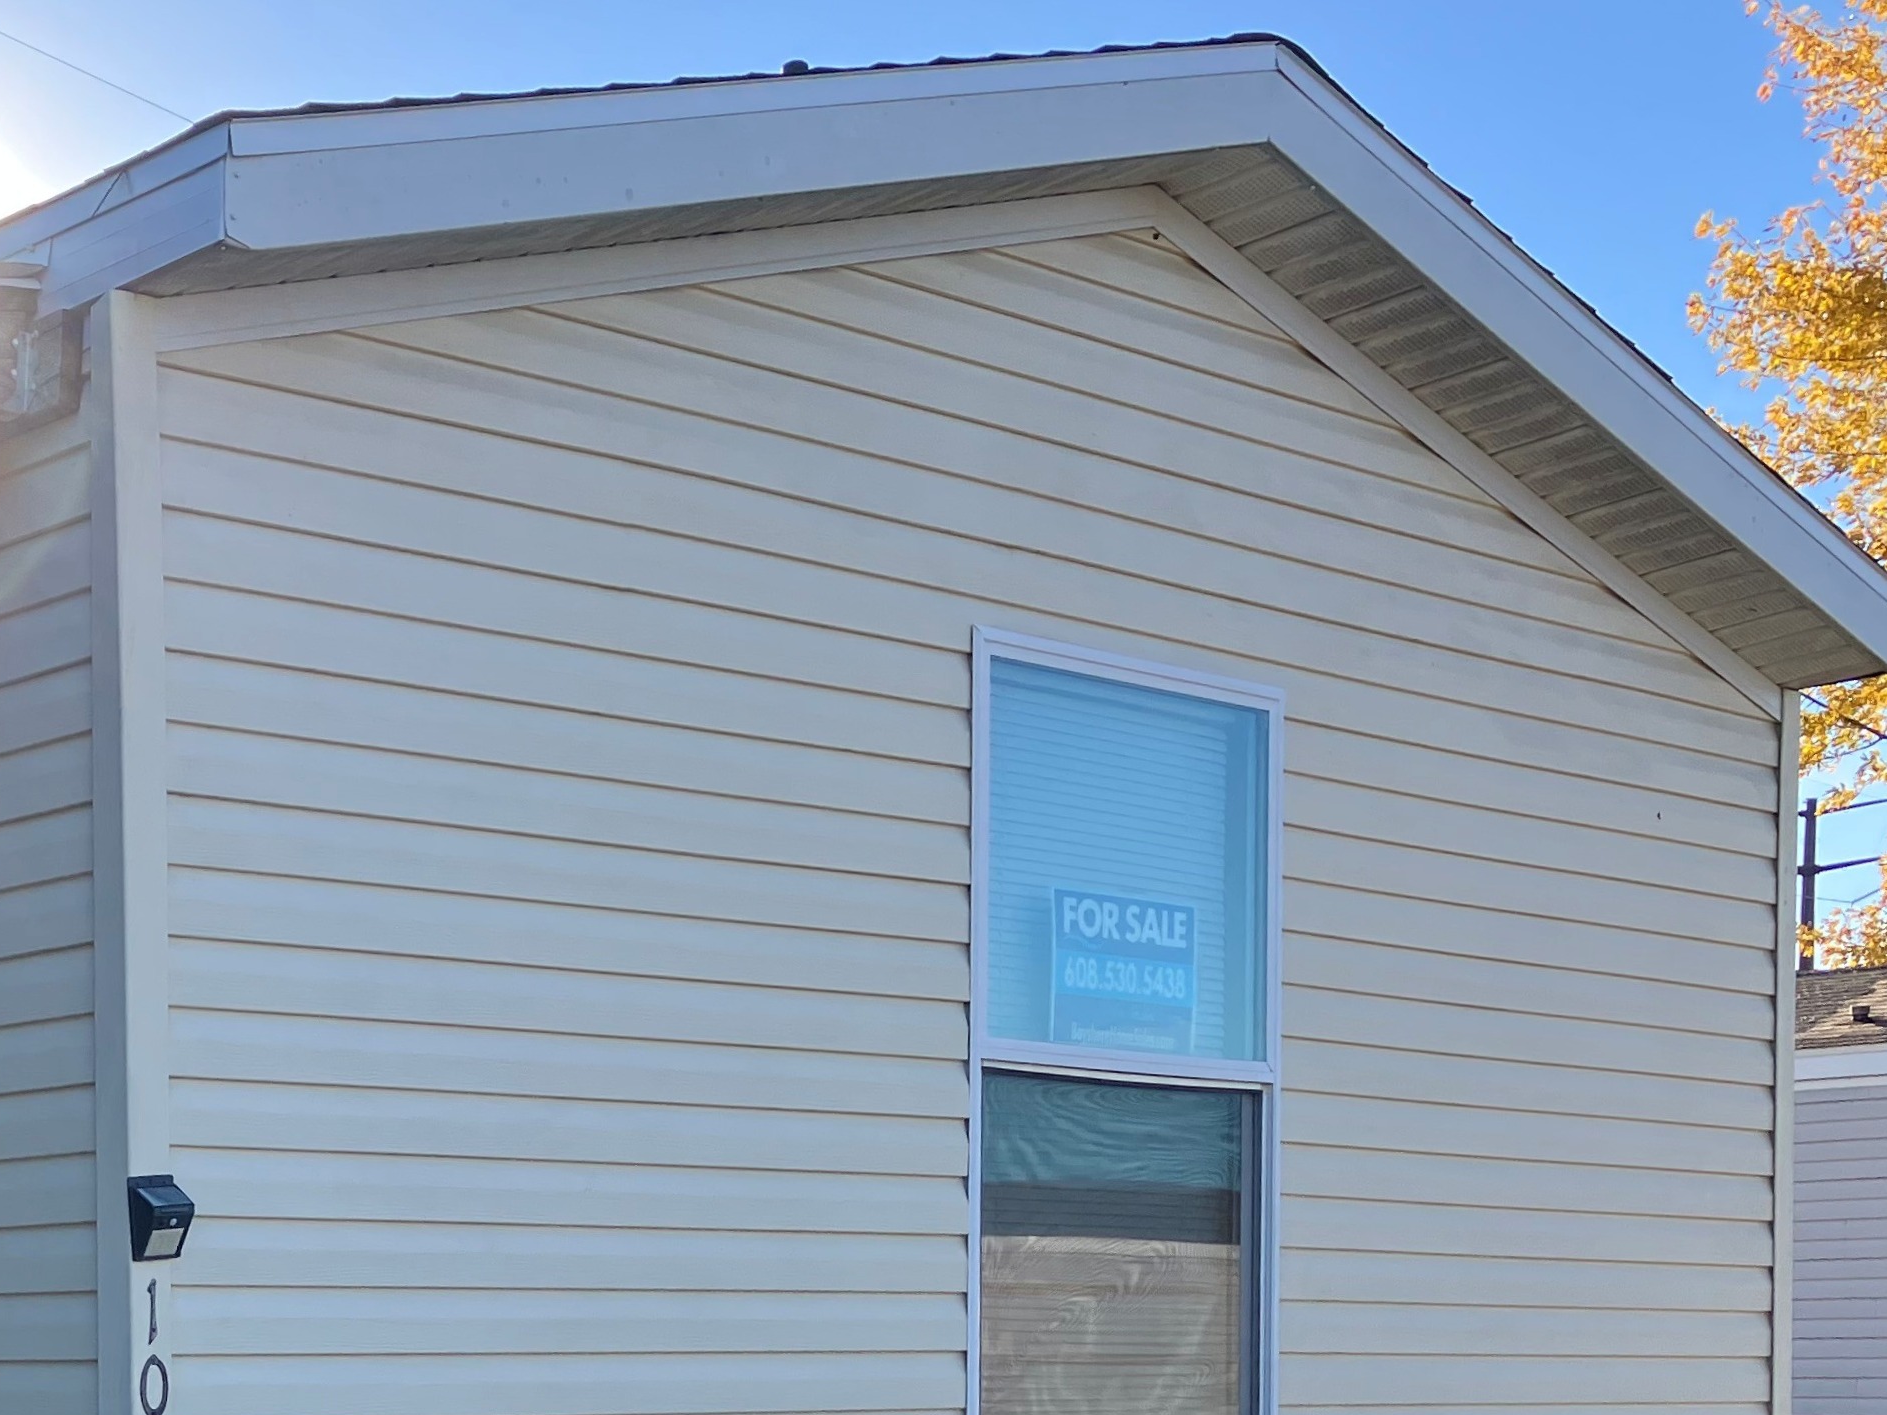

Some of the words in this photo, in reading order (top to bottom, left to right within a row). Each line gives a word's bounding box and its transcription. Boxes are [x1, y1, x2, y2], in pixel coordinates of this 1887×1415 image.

[1063, 897, 1120, 940] FOR
[1125, 905, 1187, 949] SALE
[1064, 957, 1186, 999] 608.530.5438
